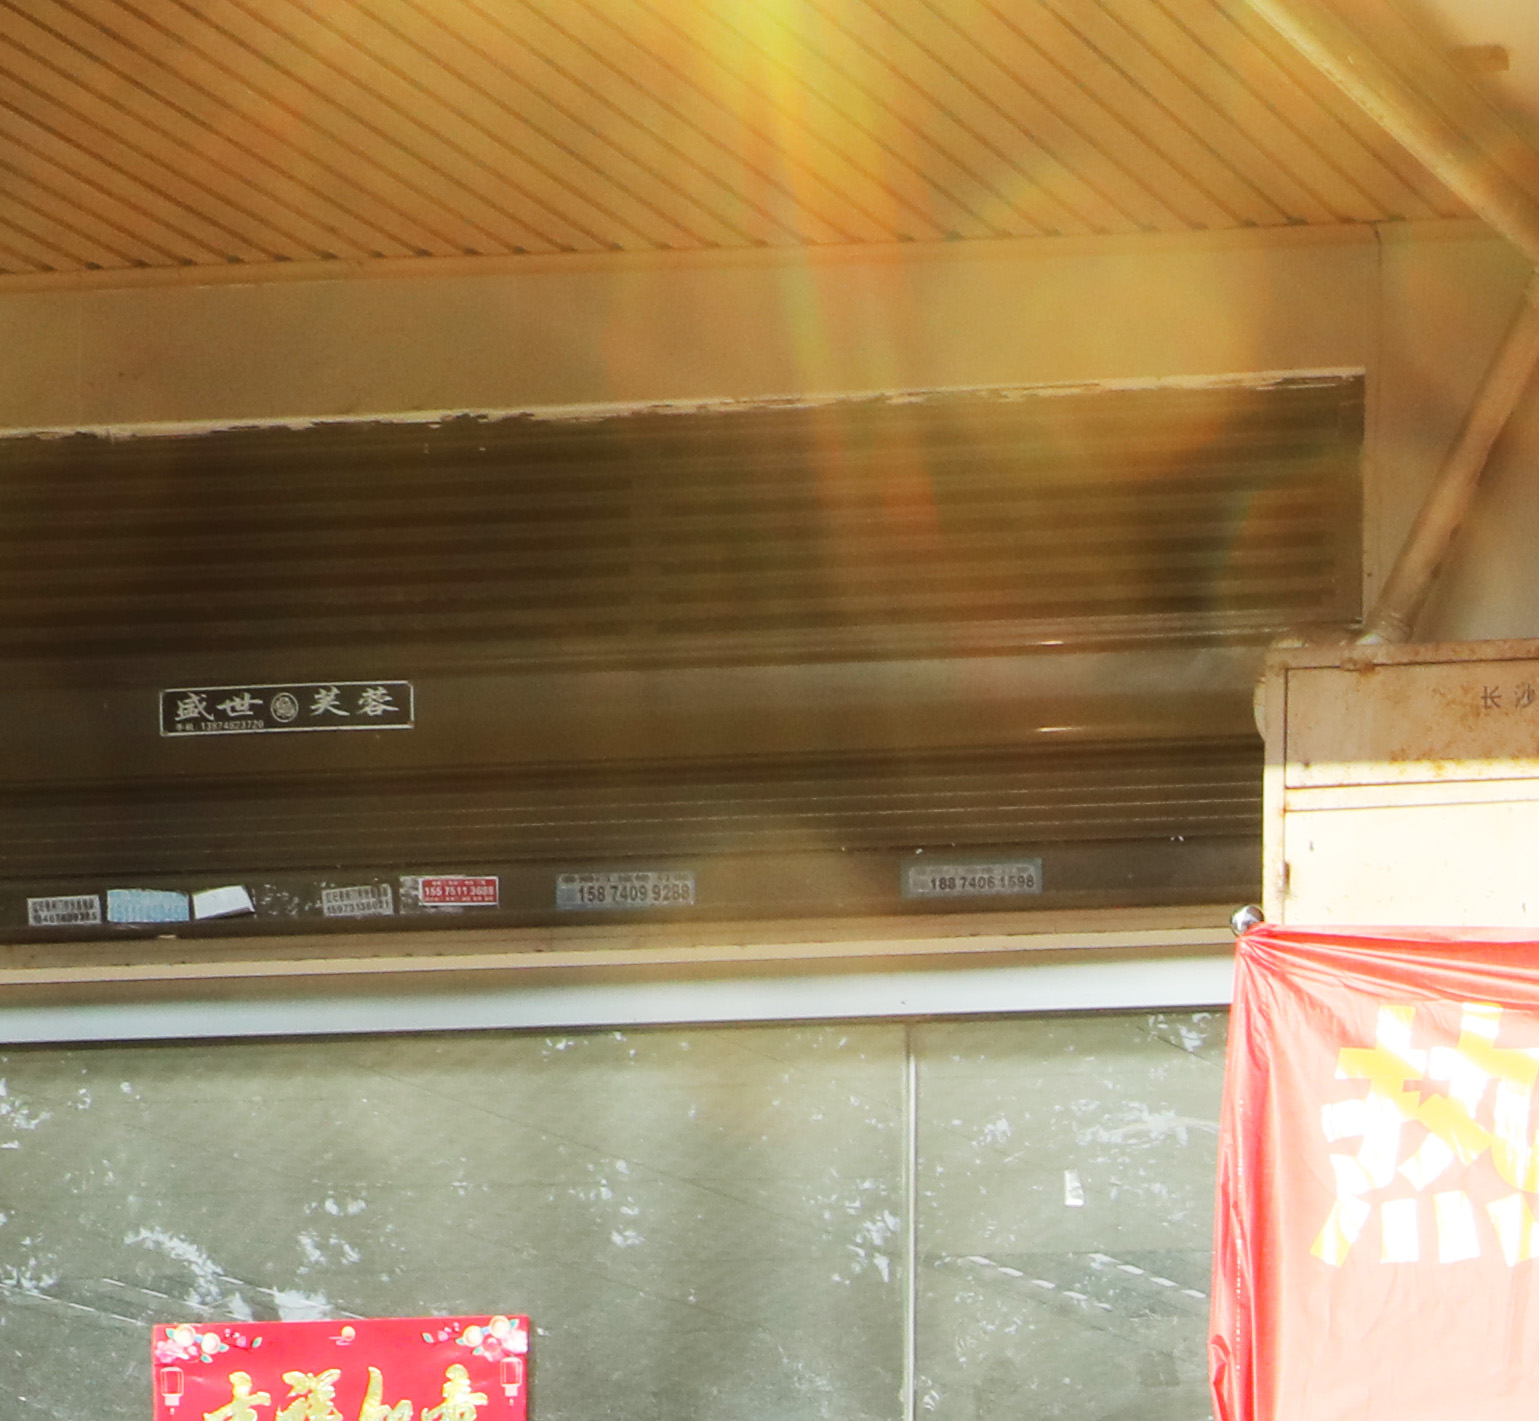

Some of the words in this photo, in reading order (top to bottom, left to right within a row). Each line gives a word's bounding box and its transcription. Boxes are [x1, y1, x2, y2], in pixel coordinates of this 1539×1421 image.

[174, 691, 263, 721] 盛世
[310, 686, 400, 716] 芙蓉
[578, 886, 606, 902] 158
[610, 885, 647, 902] 7409
[652, 884, 690, 901] 9288
